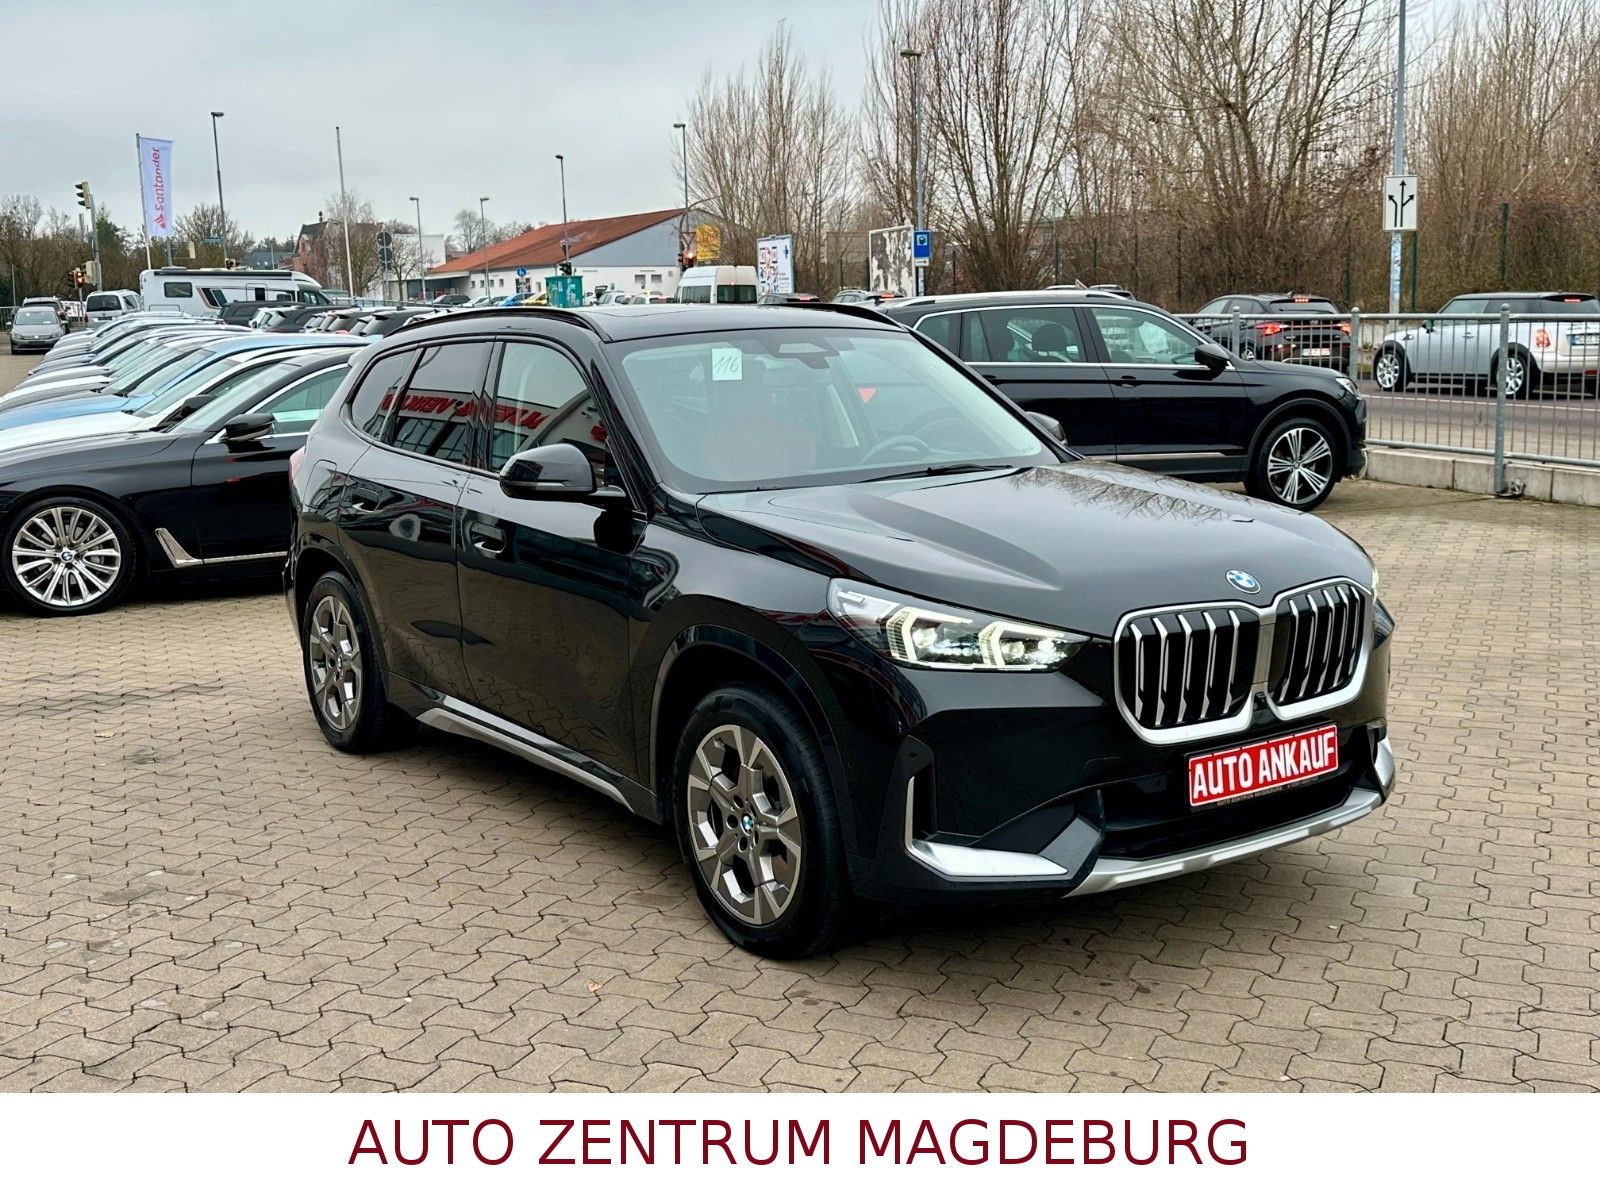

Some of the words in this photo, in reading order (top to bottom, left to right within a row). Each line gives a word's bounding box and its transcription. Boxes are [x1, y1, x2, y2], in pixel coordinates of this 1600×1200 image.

[152, 147, 164, 211] Santander
[714, 356, 739, 374] 116
[1193, 752, 1254, 799] AUTO
[1258, 731, 1335, 784] ANKAUF
